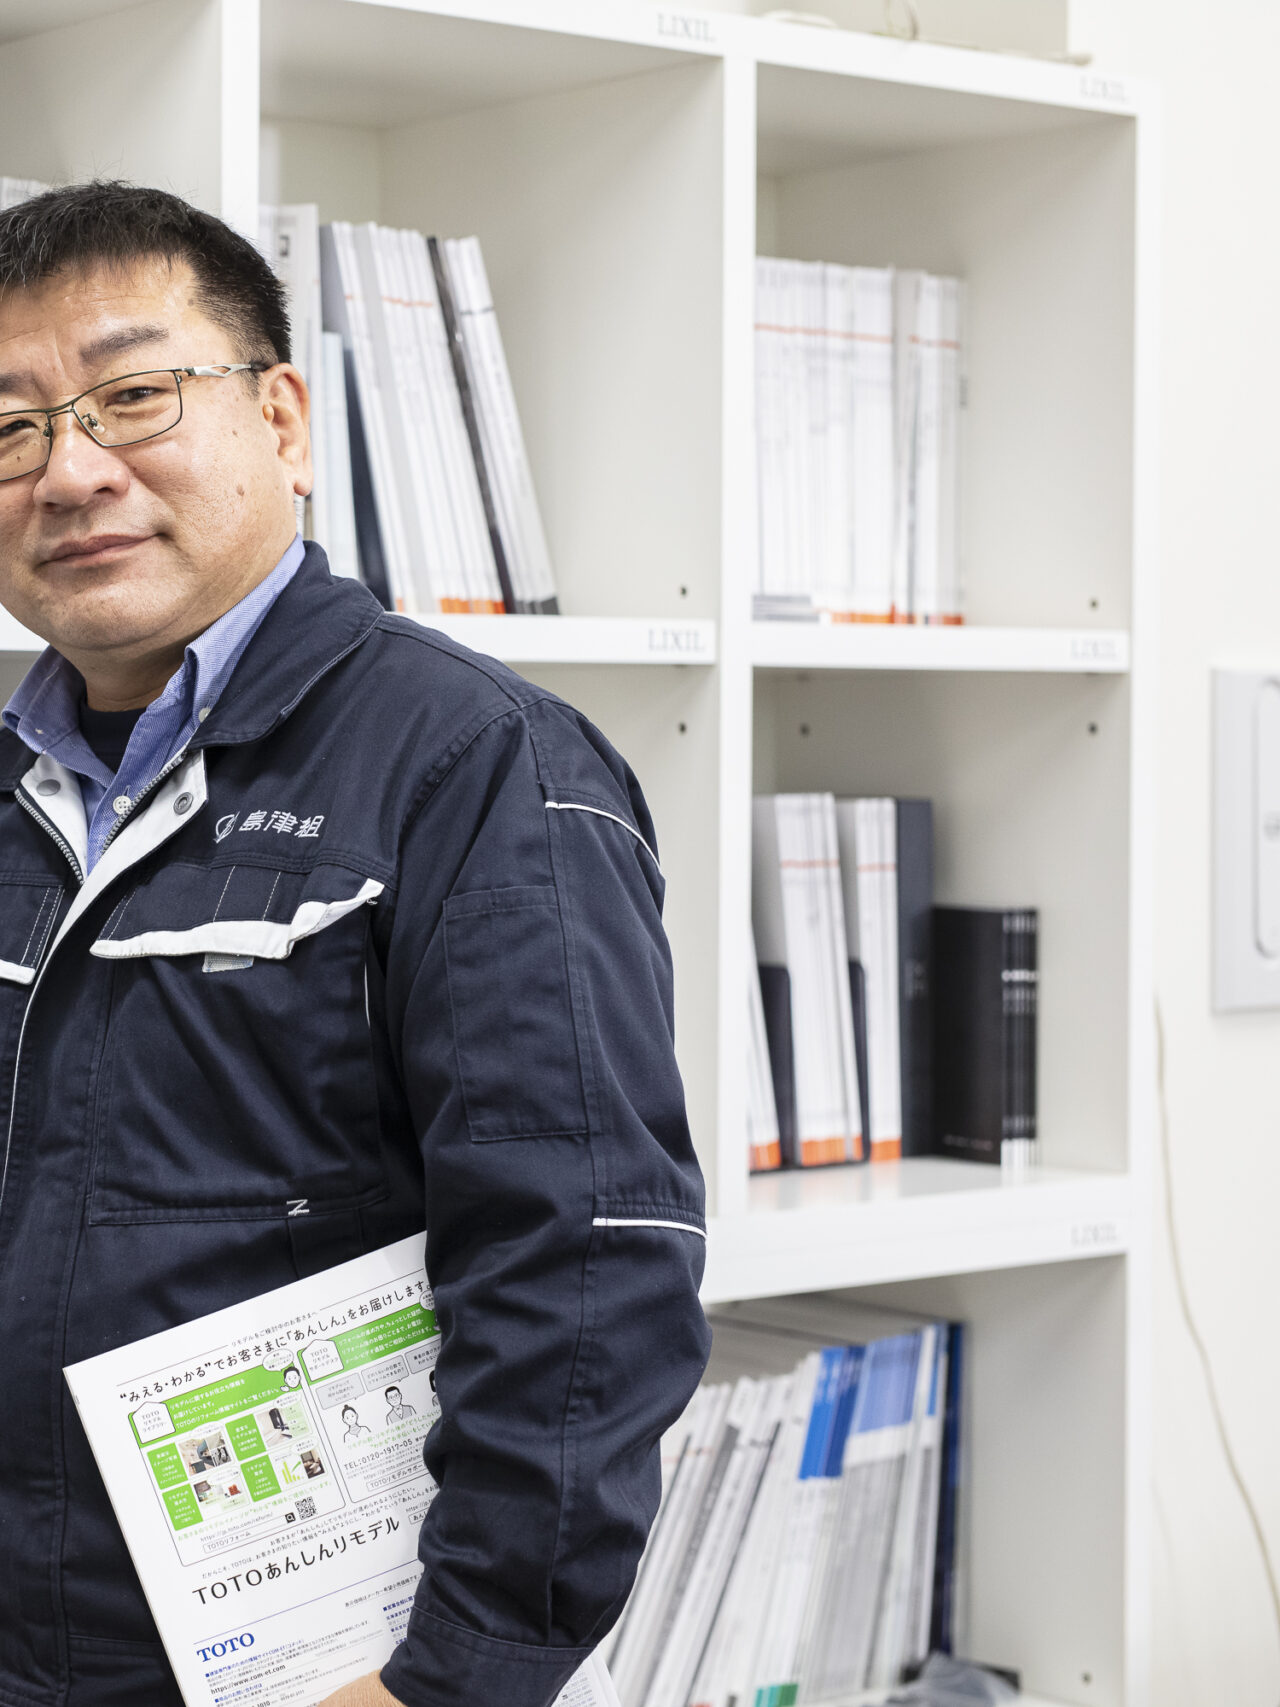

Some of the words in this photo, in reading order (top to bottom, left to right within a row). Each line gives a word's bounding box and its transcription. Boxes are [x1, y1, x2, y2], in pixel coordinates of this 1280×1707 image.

[657, 13, 717, 43] LIXIL
[648, 628, 706, 655] LIXIL
[239, 810, 325, 838] 島津組
[344, 1438, 413, 1470] TEL:0120-1917-05
[192, 1514, 401, 1607] TOTOあんしんリモデル
[196, 1630, 256, 1663] TOTO
